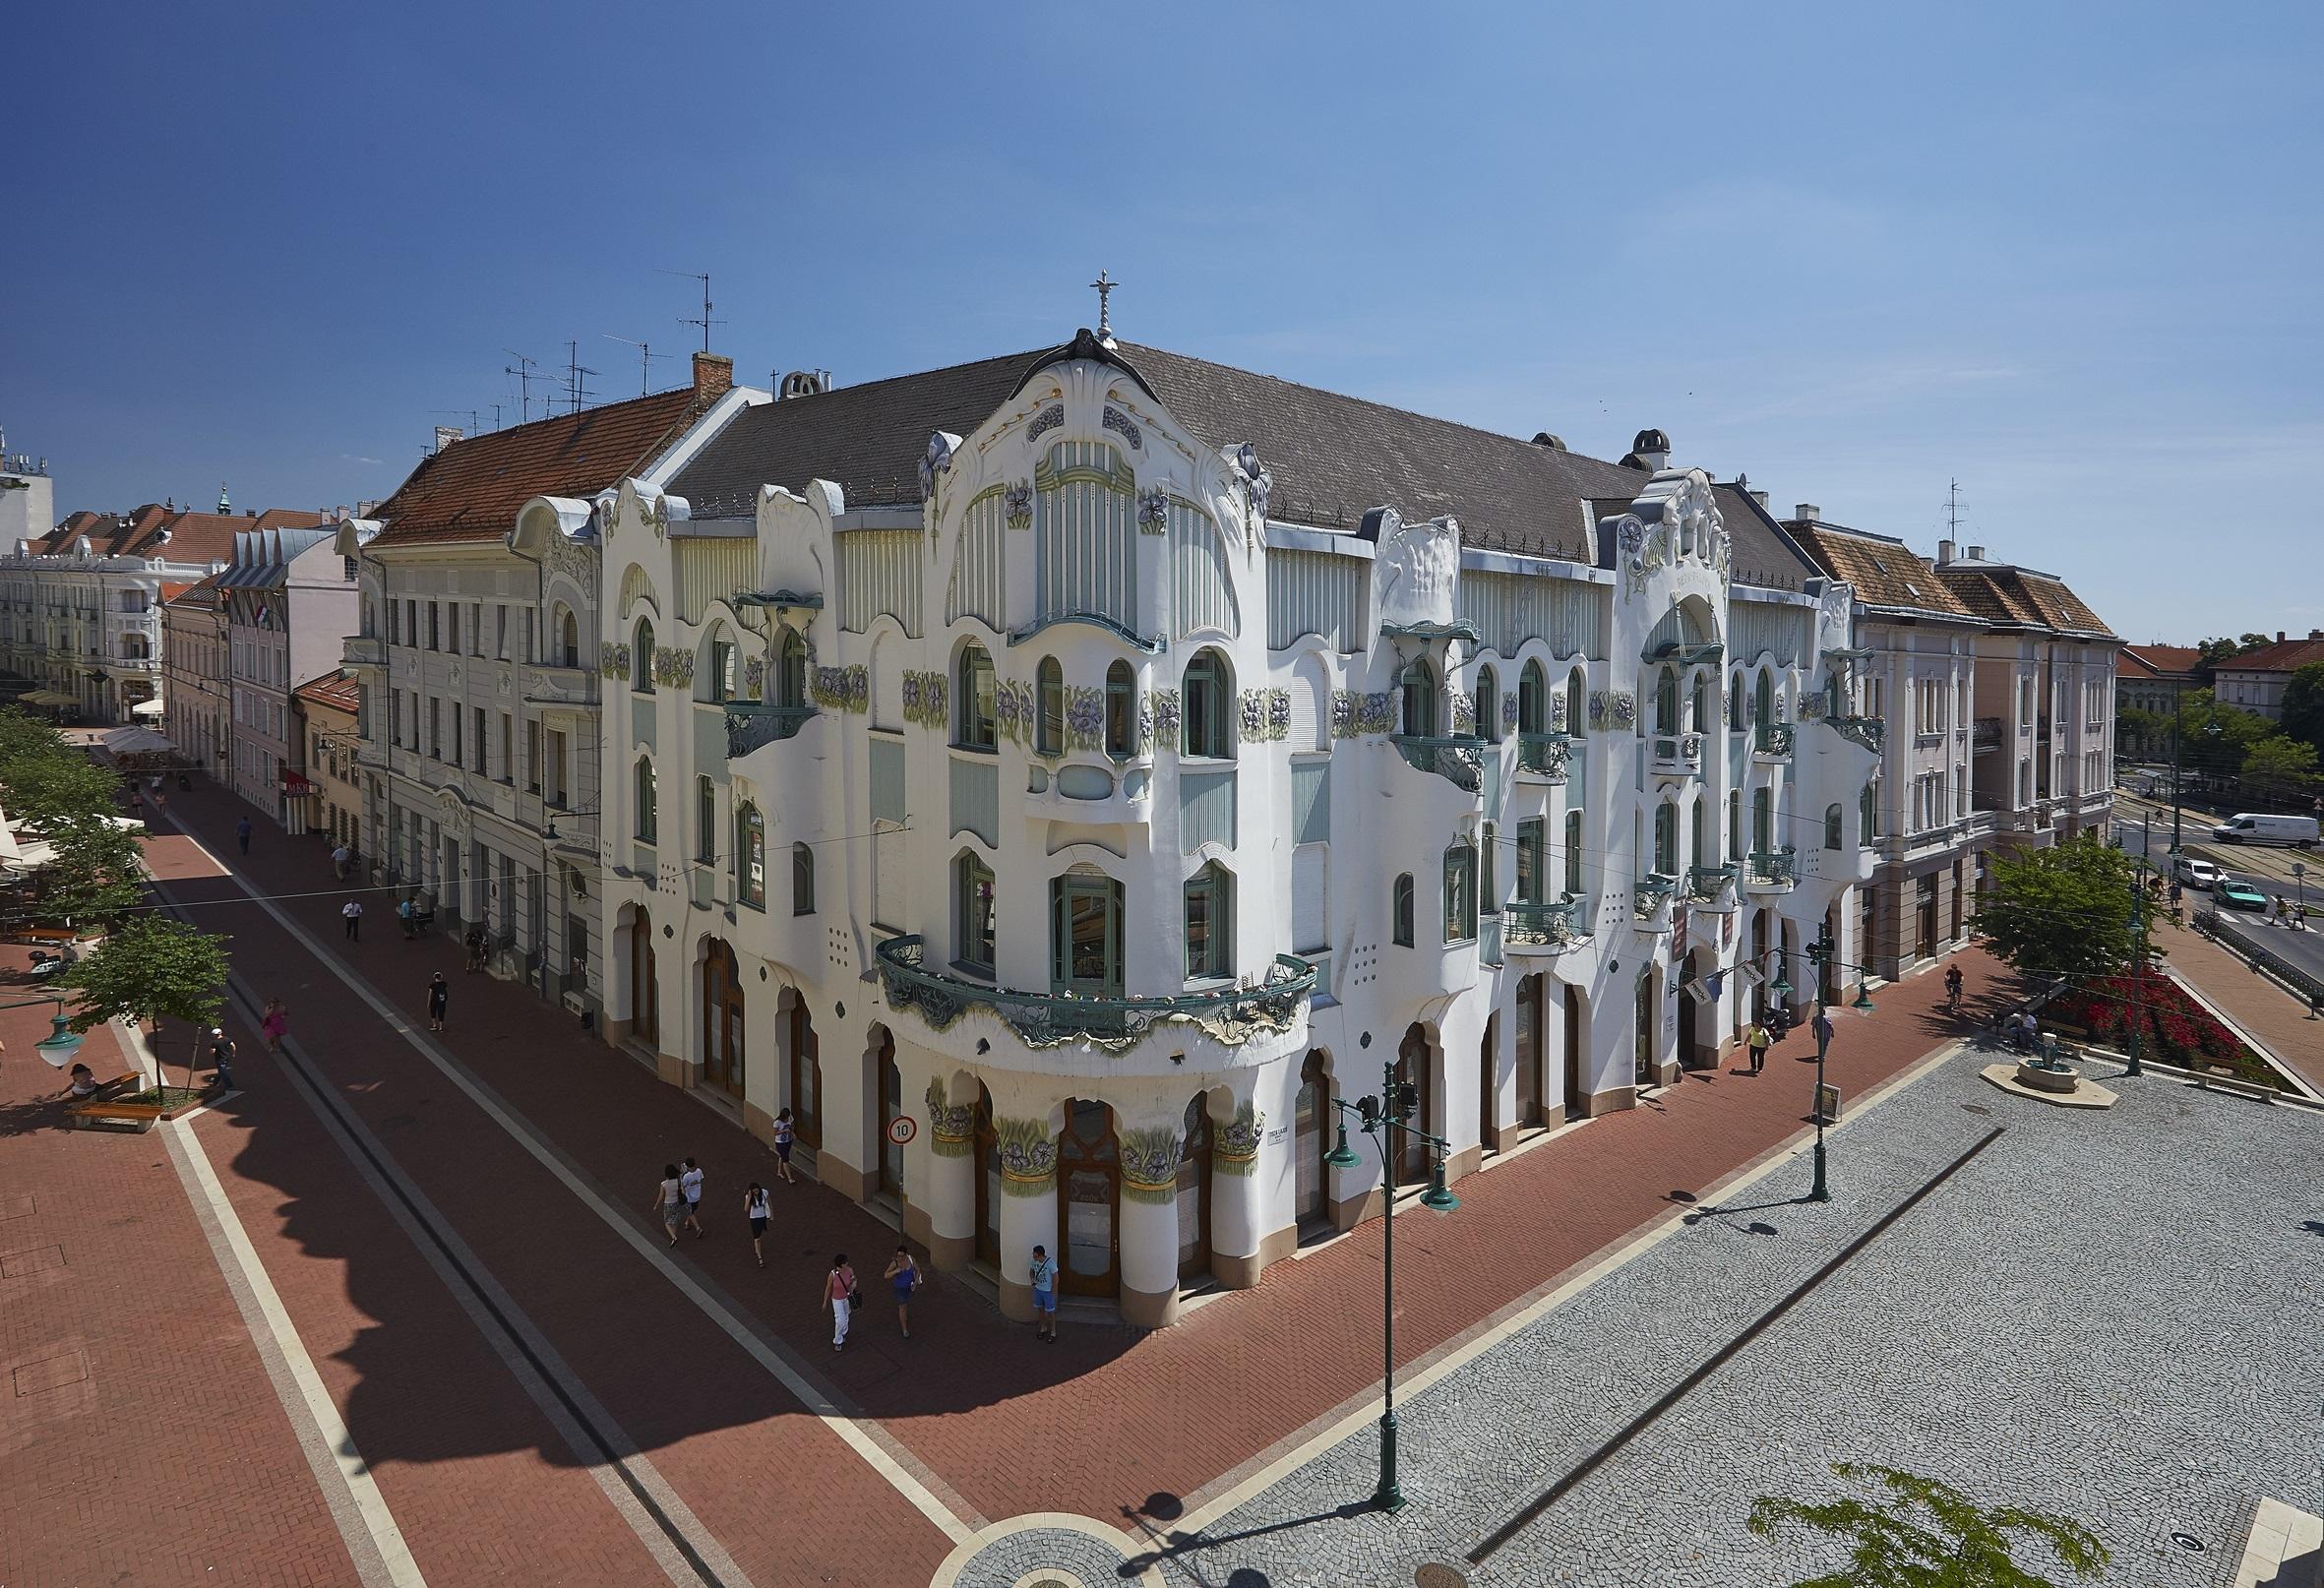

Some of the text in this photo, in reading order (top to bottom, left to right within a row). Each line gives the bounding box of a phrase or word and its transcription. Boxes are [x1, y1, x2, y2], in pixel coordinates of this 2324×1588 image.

[287, 782, 308, 794] MKB
[1690, 983, 1707, 1003] REÖK
[896, 1124, 908, 1136] 10
